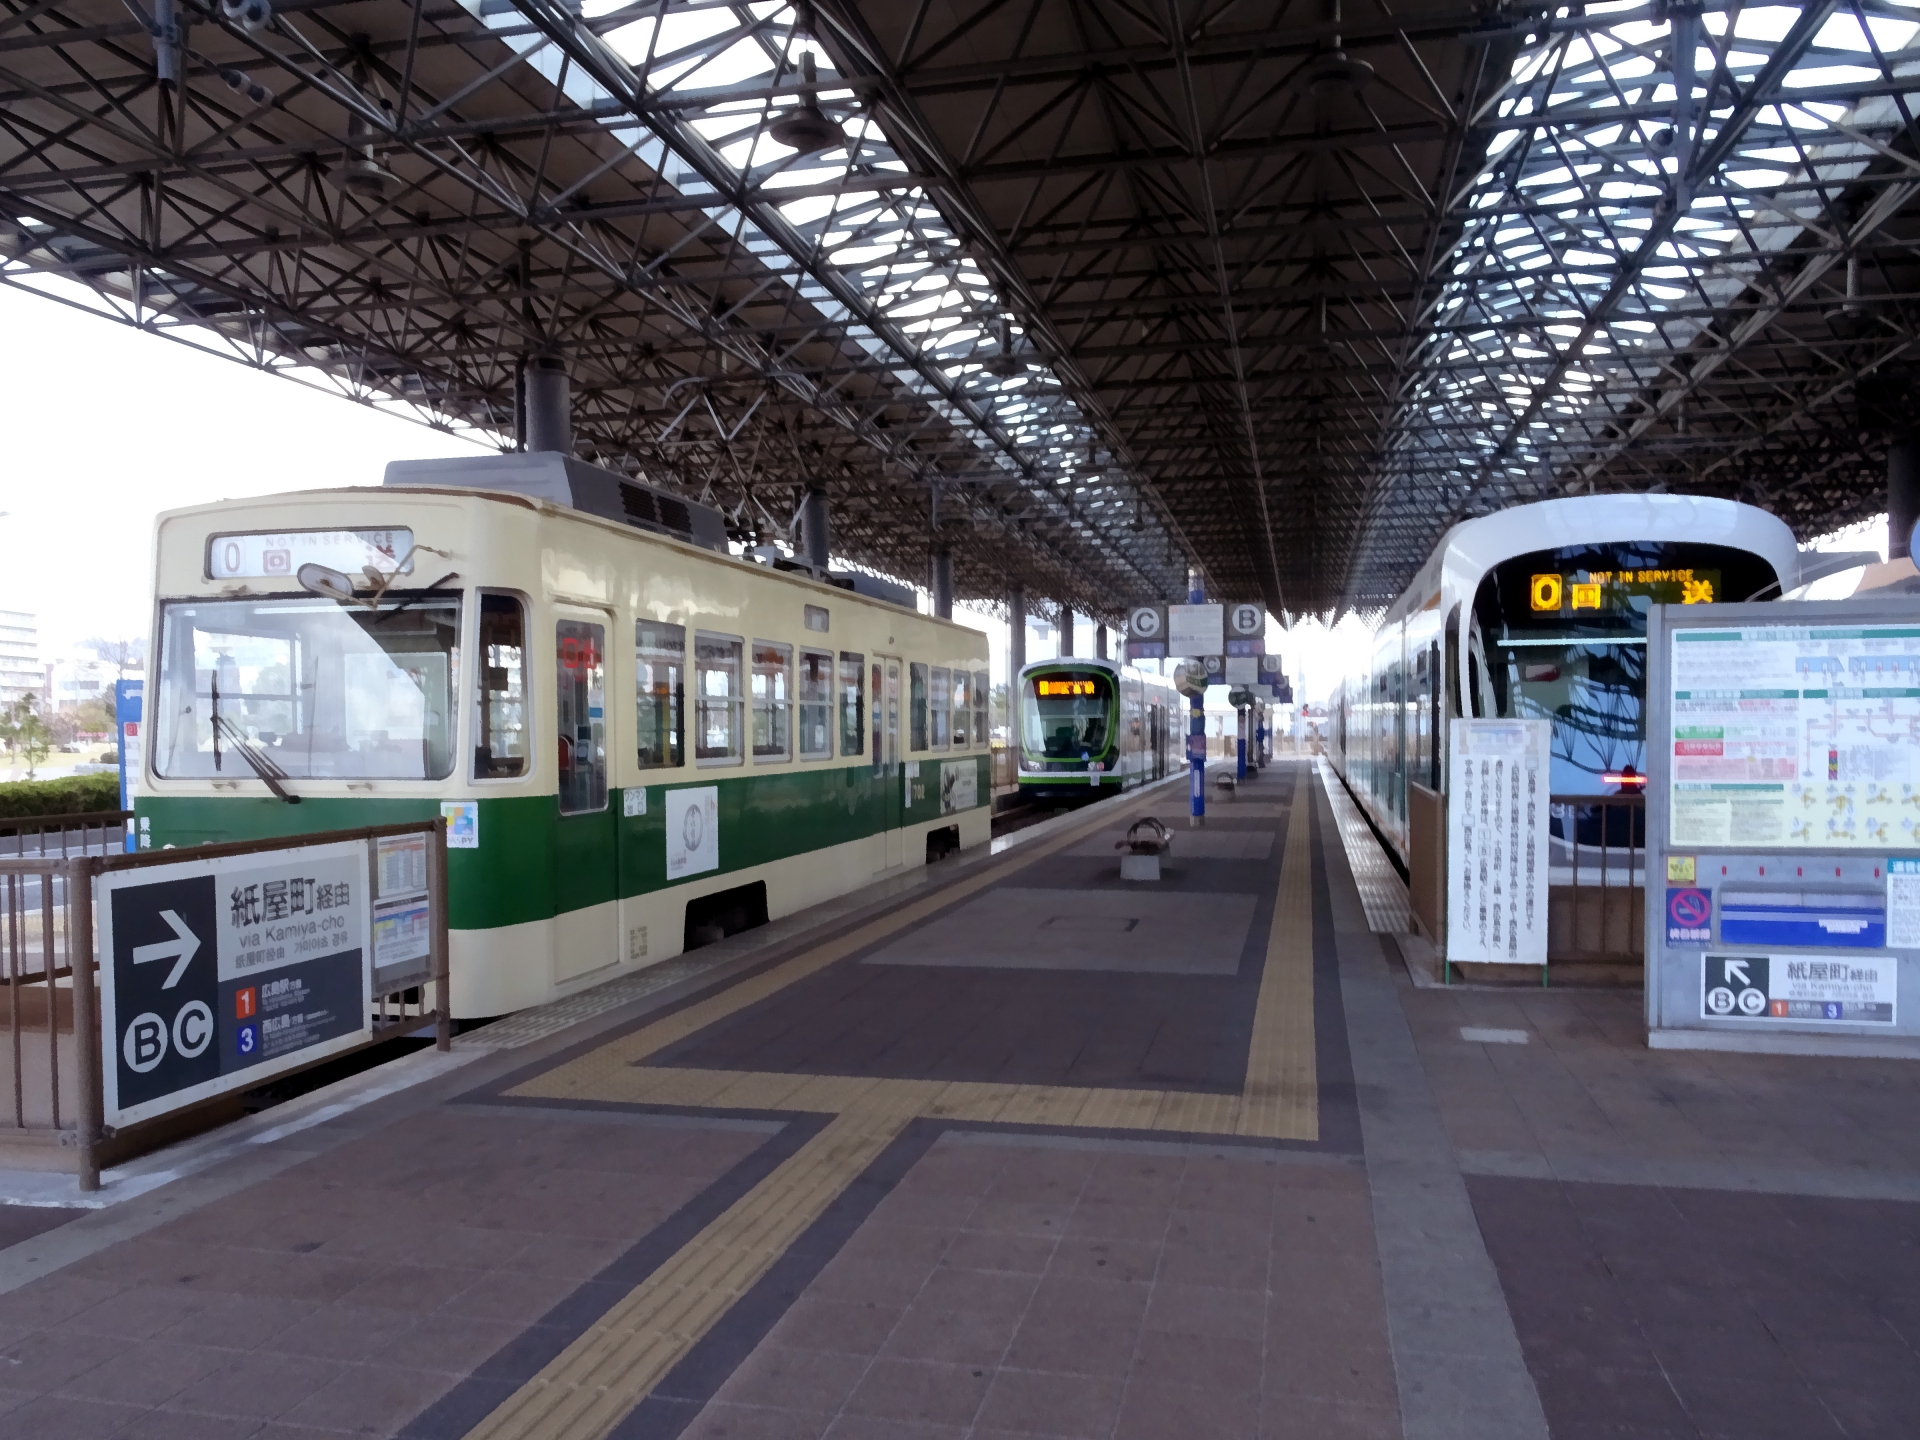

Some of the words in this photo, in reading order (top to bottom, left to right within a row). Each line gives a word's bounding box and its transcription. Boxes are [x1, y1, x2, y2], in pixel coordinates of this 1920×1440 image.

[266, 535, 297, 548] NOT
[302, 535, 317, 546] IN
[323, 532, 394, 546] SERVICE
[224, 542, 241, 573] 0
[1589, 571, 1613, 584] NOT
[1619, 570, 1633, 583] IN
[1638, 568, 1694, 583] SERVICE
[1537, 576, 1557, 609] 0
[1136, 612, 1154, 632] C
[1239, 609, 1256, 629] B
[1206, 658, 1218, 670] C
[625, 789, 645, 802] ワンマン
[447, 837, 474, 845] ASPY
[230, 877, 350, 929] 紙屋町経由
[239, 930, 260, 949] via
[265, 914, 345, 943] Kamiya-cho
[1787, 961, 1878, 983] 紙屋町経由
[241, 990, 251, 1015] 1
[1714, 992, 1731, 1008] B
[1743, 992, 1760, 1009] C
[1827, 1003, 1837, 1018] 3
[134, 1020, 162, 1065] B
[179, 1008, 207, 1051] C
[241, 1027, 254, 1052] 3
